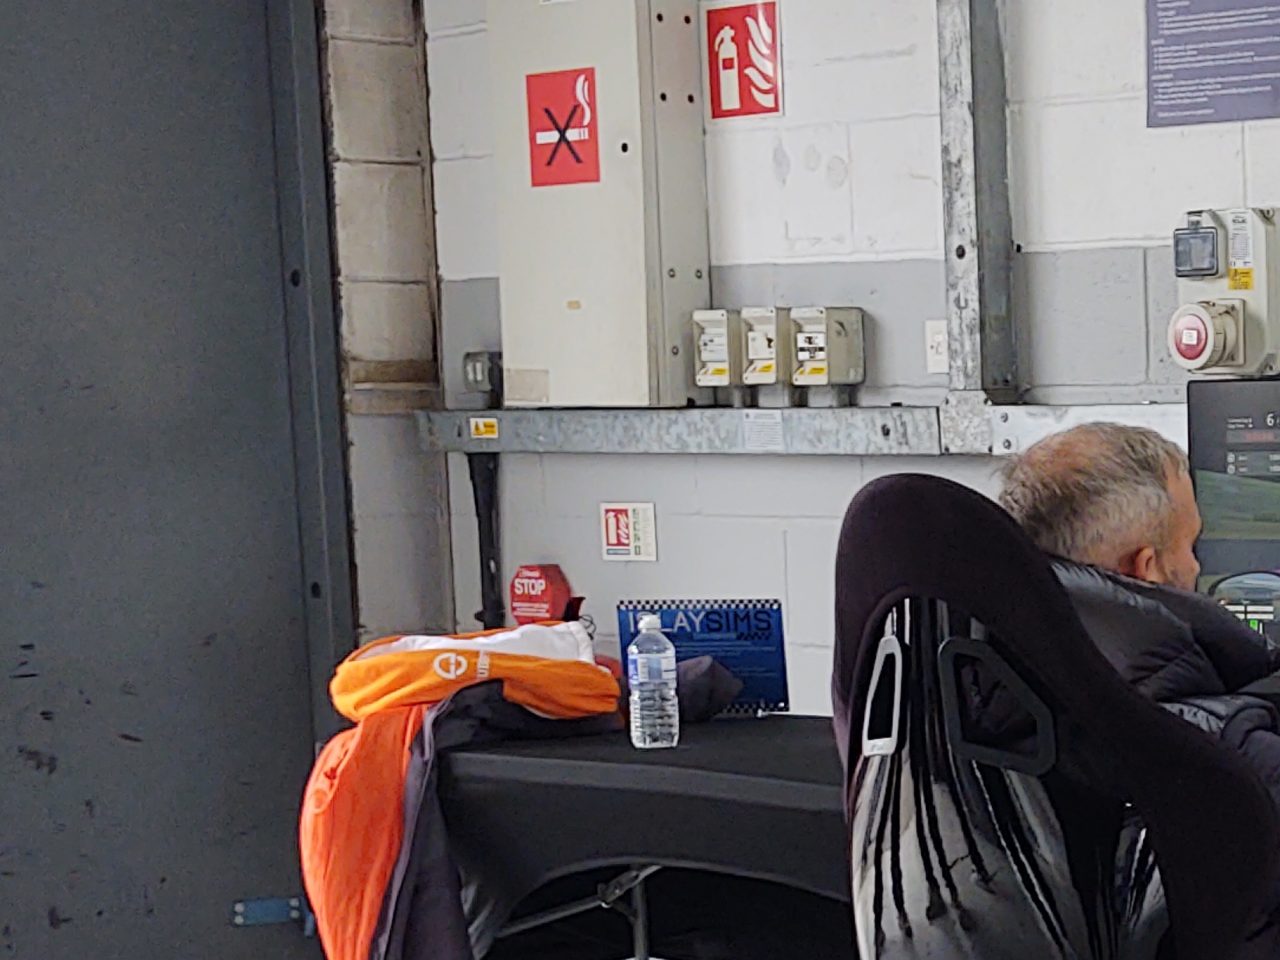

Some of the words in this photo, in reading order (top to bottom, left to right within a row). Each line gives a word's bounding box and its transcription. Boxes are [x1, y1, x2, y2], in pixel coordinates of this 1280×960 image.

[1266, 413, 1275, 427] 6
[514, 578, 546, 595] STOP
[628, 610, 772, 633] ILAYSIMS
